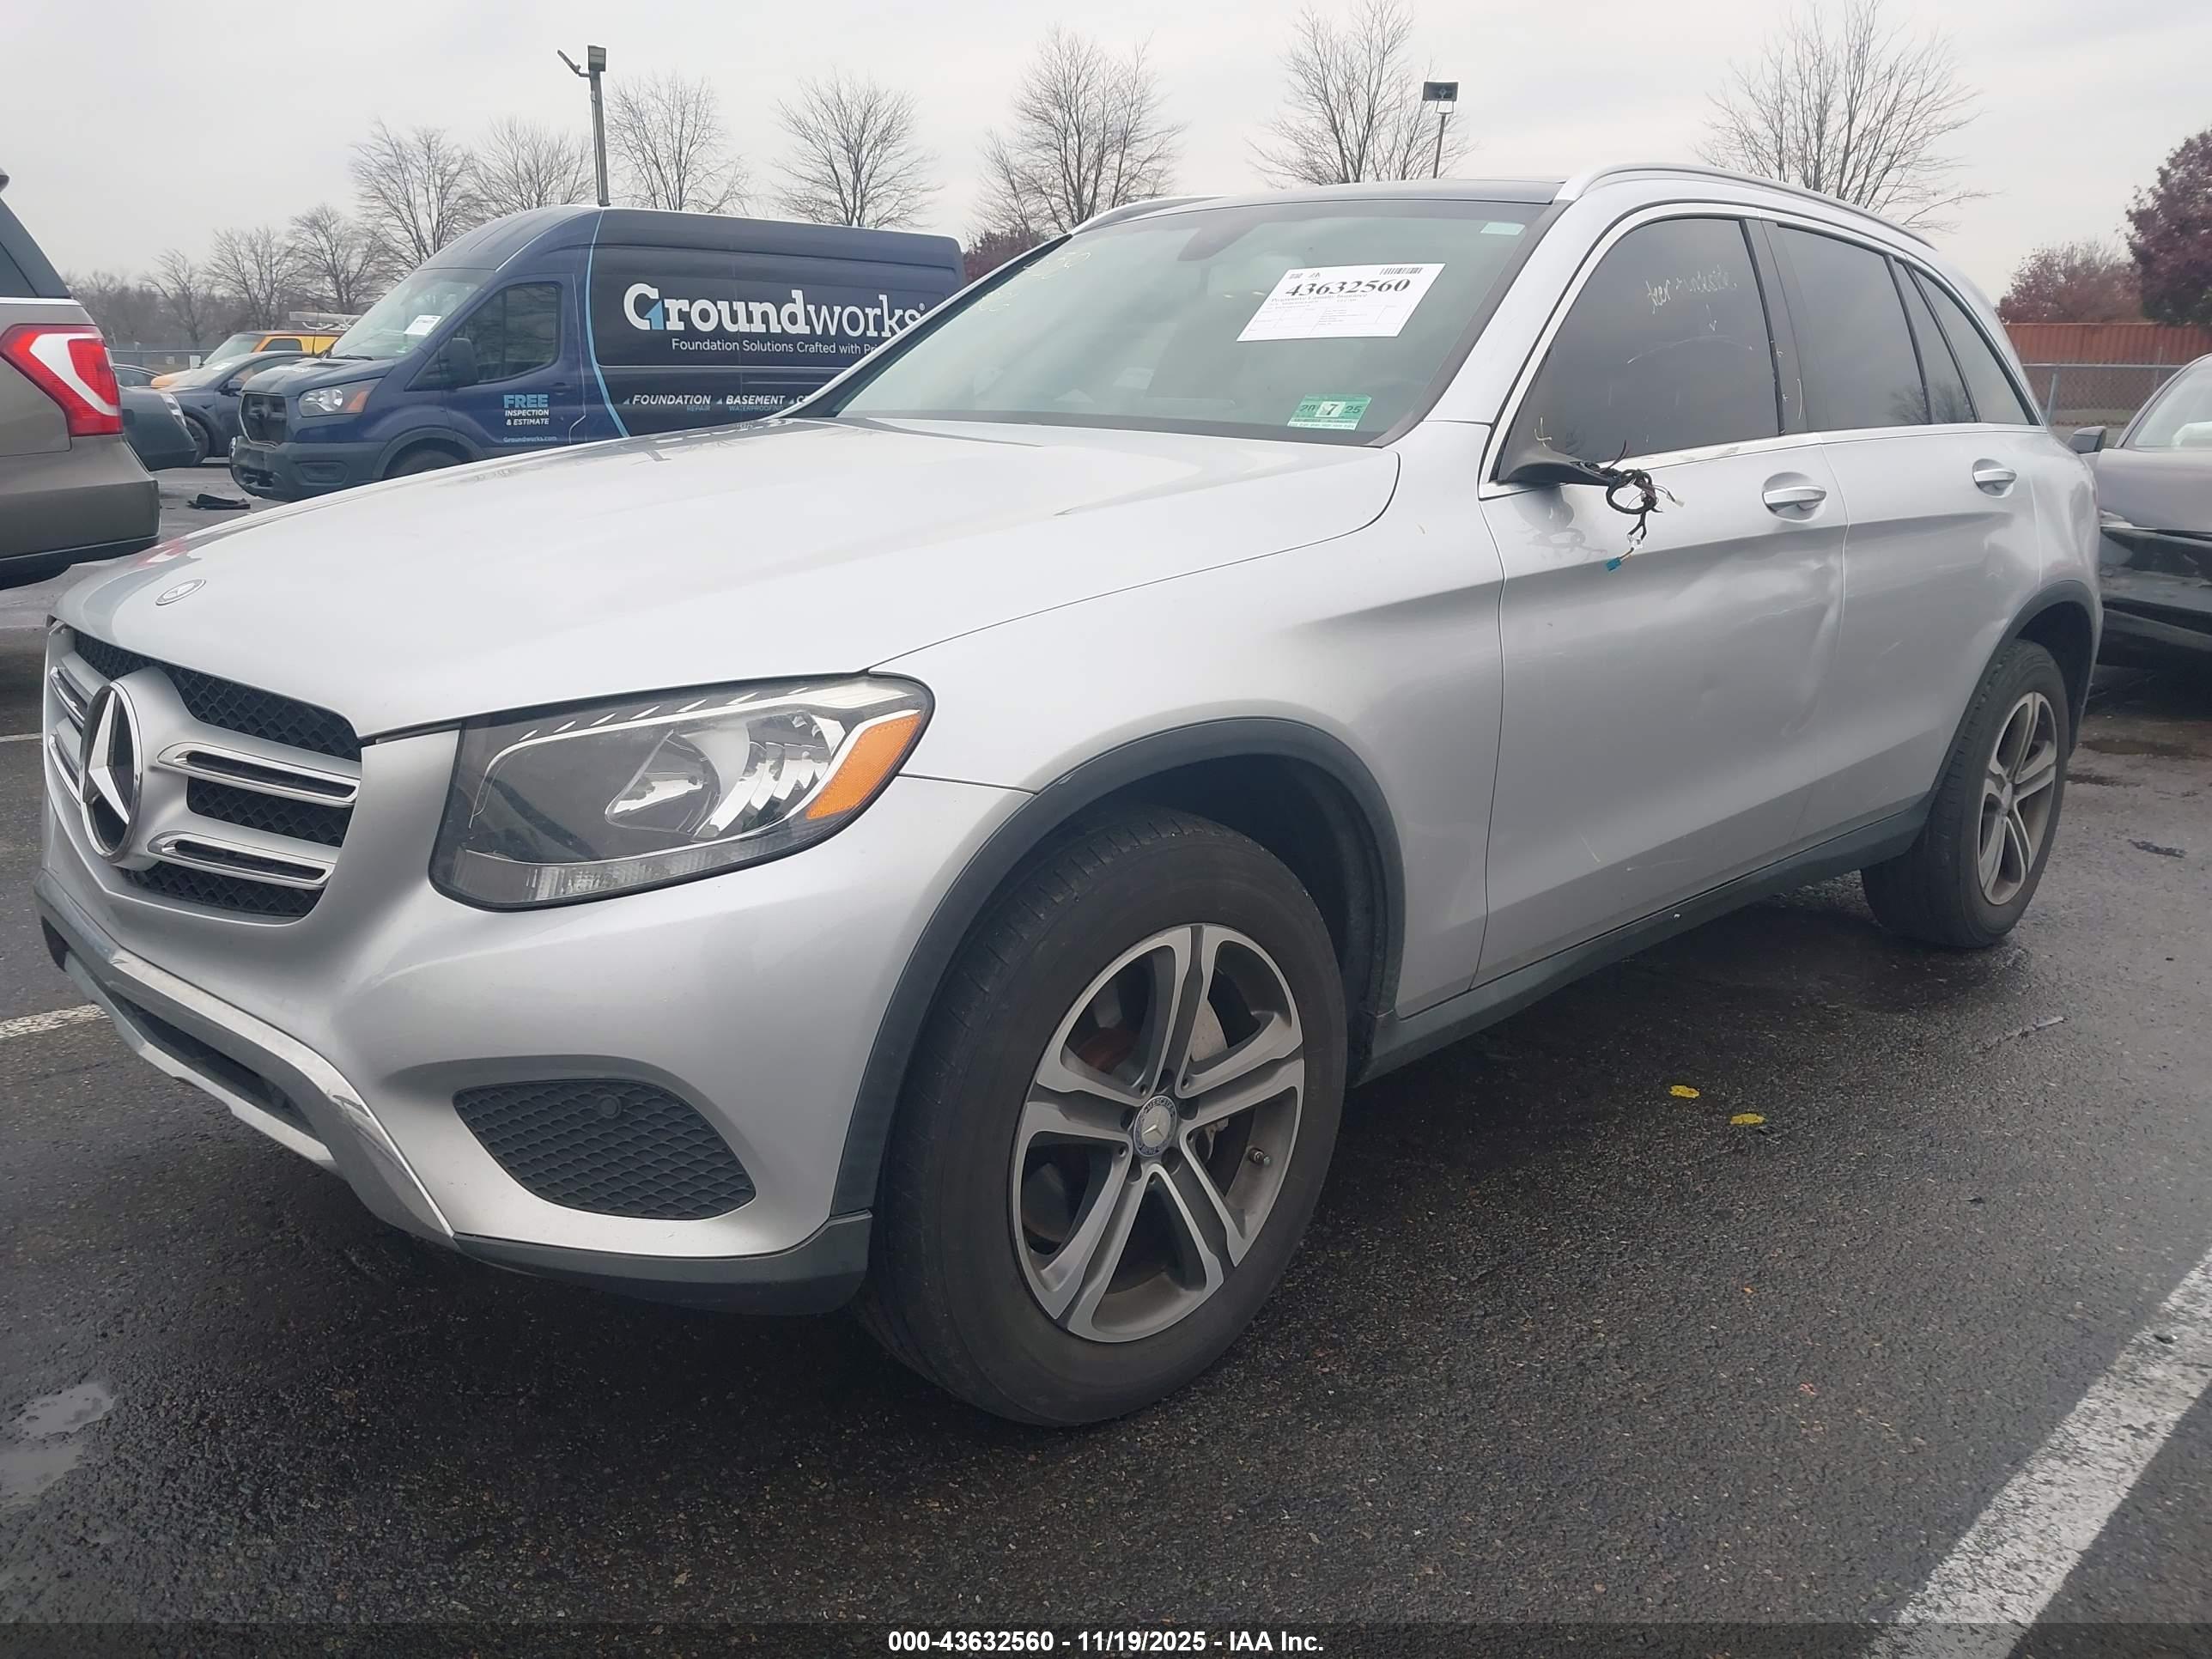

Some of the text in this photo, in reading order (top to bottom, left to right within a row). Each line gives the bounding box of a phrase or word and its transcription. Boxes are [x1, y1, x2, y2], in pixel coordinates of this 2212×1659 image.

[1285, 278, 1411, 296] 43632560
[672, 338, 739, 350] Foundation
[743, 340, 793, 352] Solutions
[797, 342, 836, 354] Crafted
[839, 343, 860, 355] with
[503, 394, 549, 408] FREE
[632, 394, 711, 405] FOUNDATION
[726, 394, 786, 405] BASEMENT
[1344, 405, 1362, 414] 25
